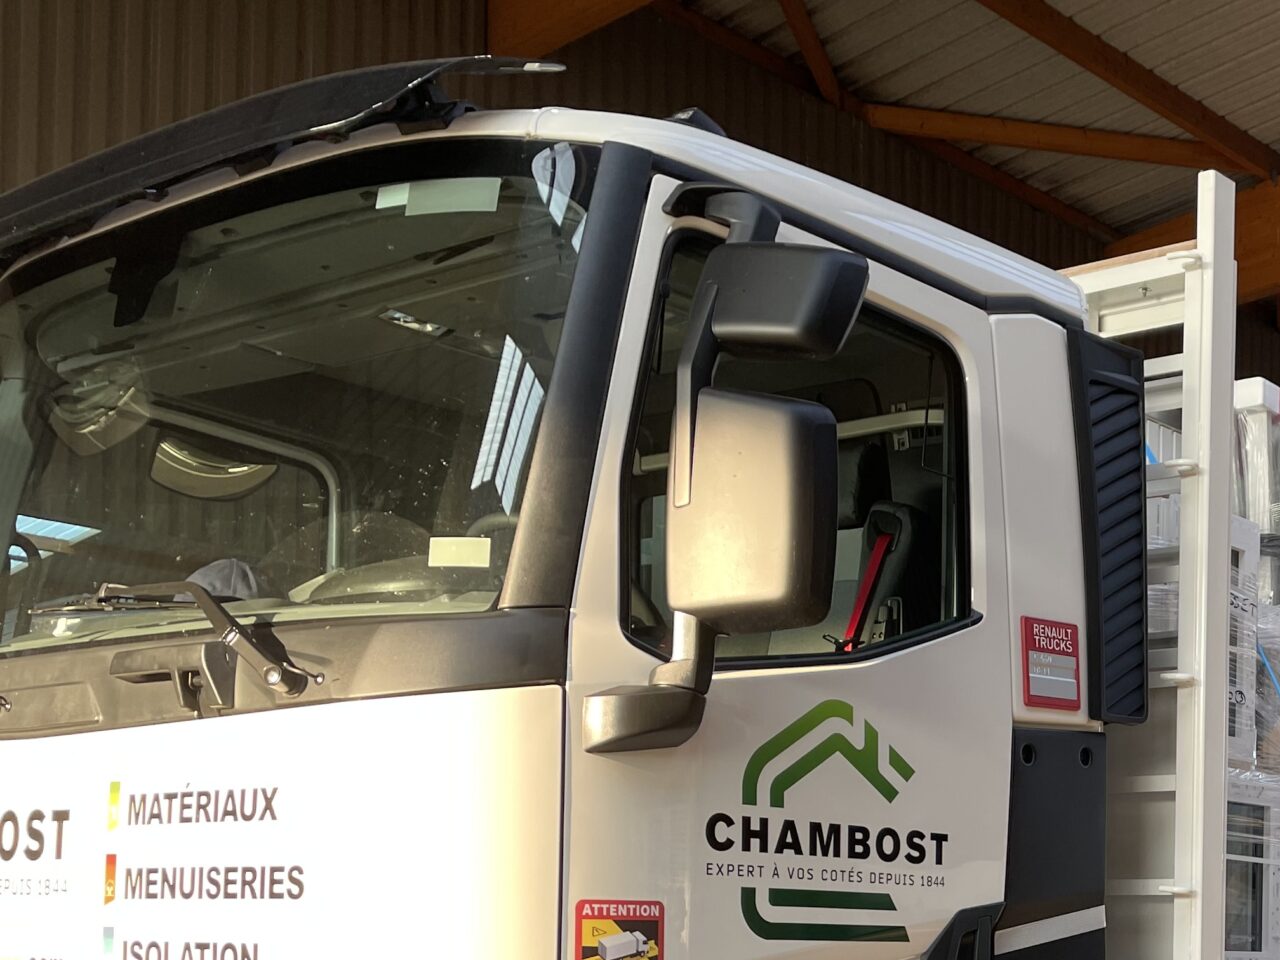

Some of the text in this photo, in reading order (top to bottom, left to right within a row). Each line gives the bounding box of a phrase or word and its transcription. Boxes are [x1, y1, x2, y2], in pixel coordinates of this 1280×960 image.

[1033, 623, 1072, 640] RENAULT
[1033, 636, 1073, 653] TRUCKS
[127, 782, 279, 826] MATÉRIAUX
[0, 809, 70, 861] OST
[705, 812, 949, 866] CHAMBOST
[38, 879, 69, 896] 1844
[124, 865, 304, 900] MENUISERIES
[705, 862, 946, 888] EXPERT À VOS COTÉS DEPUIS 1844
[582, 903, 660, 917] ATTENTION
